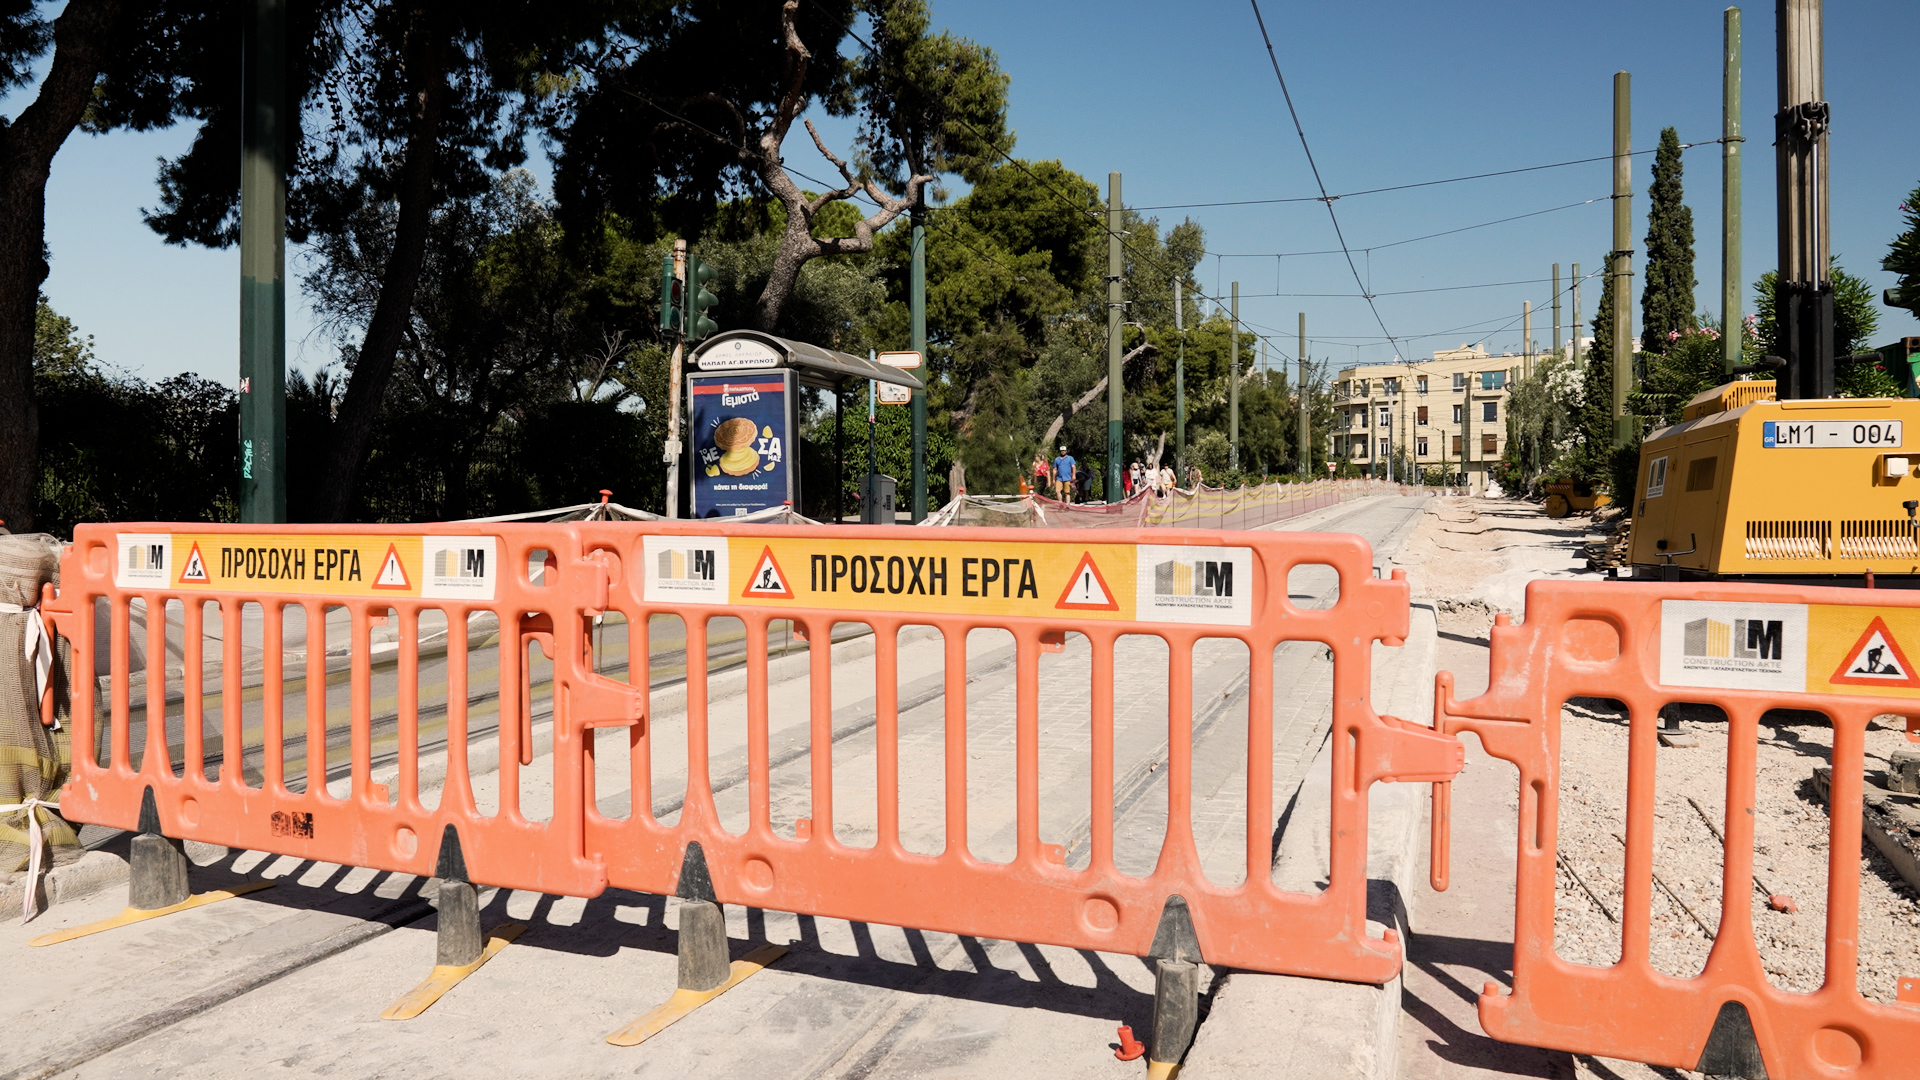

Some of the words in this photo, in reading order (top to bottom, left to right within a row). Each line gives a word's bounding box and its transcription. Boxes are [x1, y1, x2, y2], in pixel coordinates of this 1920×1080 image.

[722, 389, 760, 408] Γεμιστά
[1776, 425, 1814, 444] LM1
[1853, 424, 1896, 444] 004
[702, 447, 720, 465] ΜΕ
[146, 544, 163, 569] LM
[222, 548, 306, 580] ΠΡΟΣΟΧΗ
[314, 549, 362, 581] ΕΡΓΑ
[460, 549, 484, 577] LM
[687, 550, 714, 580] LM
[811, 554, 947, 596] ΠΡΟΣΟΧΗ
[962, 558, 1038, 599] ΕΡΓΑ
[1195, 561, 1233, 597] LM
[1734, 619, 1783, 660] LM
[1683, 658, 1754, 667] CONSTRUCTION
[1757, 660, 1782, 668] AKTE
